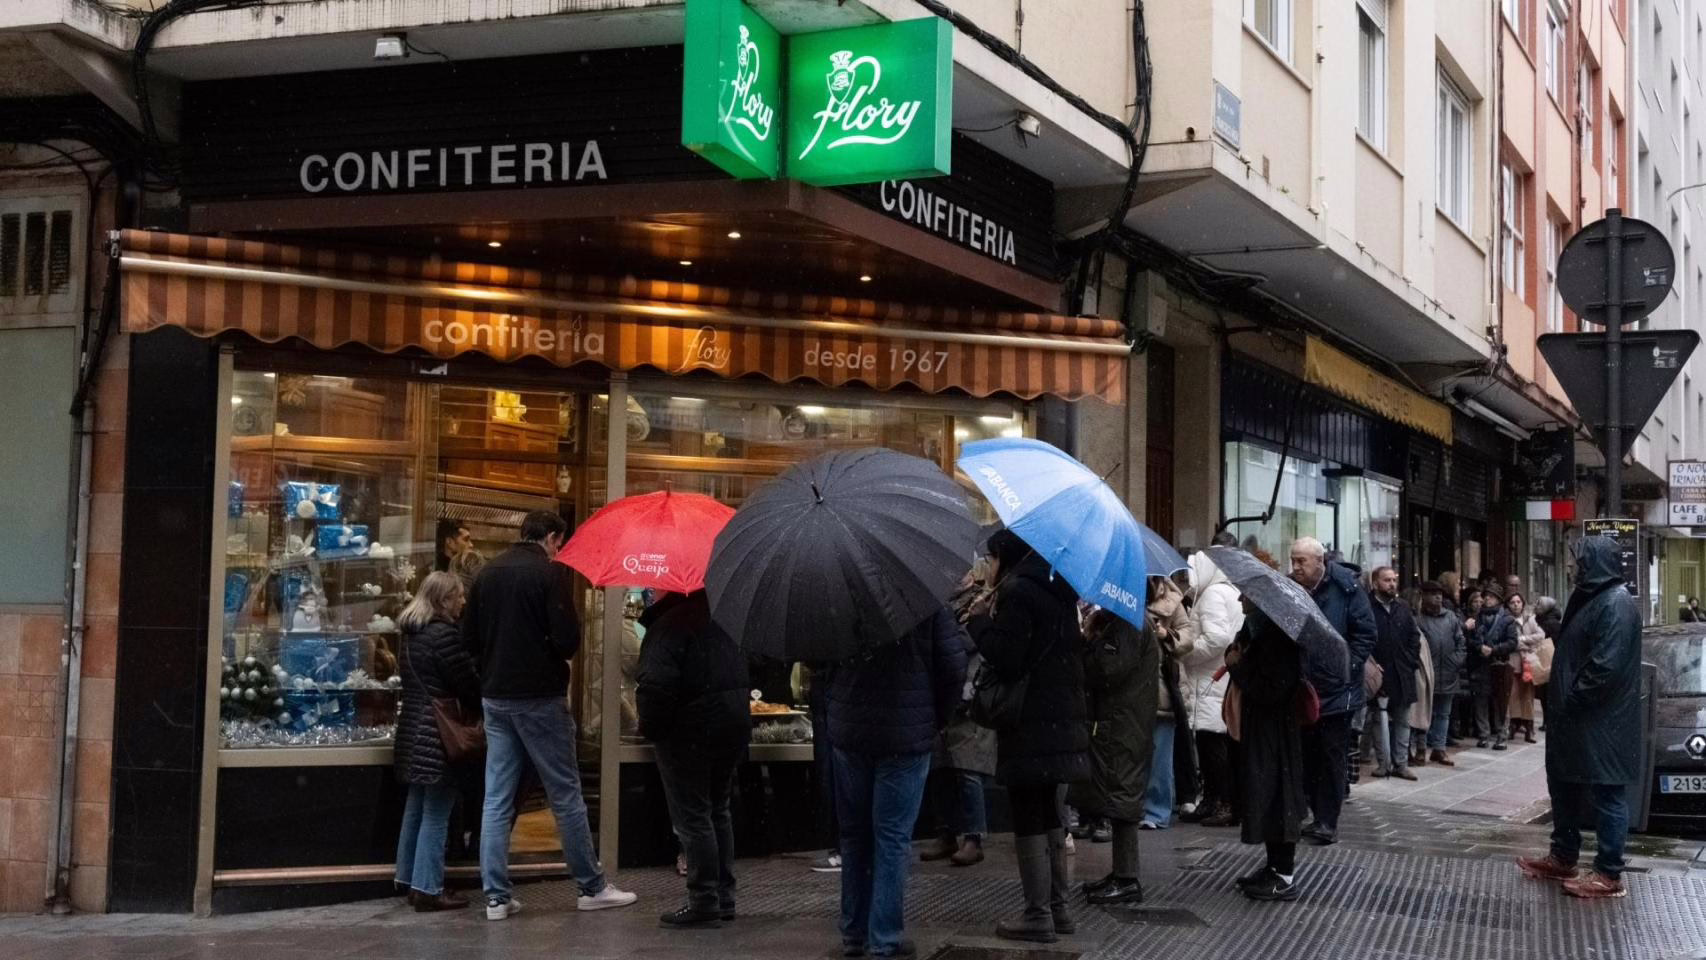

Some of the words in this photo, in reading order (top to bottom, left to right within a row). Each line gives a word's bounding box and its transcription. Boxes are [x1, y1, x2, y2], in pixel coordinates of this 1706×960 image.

[300, 139, 608, 193] CONFITERIA
[880, 179, 1017, 266] CONFITERIA
[803, 342, 877, 370] desde
[888, 348, 950, 374] 1967
[984, 467, 1023, 511] ABANCA
[1673, 505, 1697, 513] CAFE
[1103, 582, 1137, 612] ABANCA
